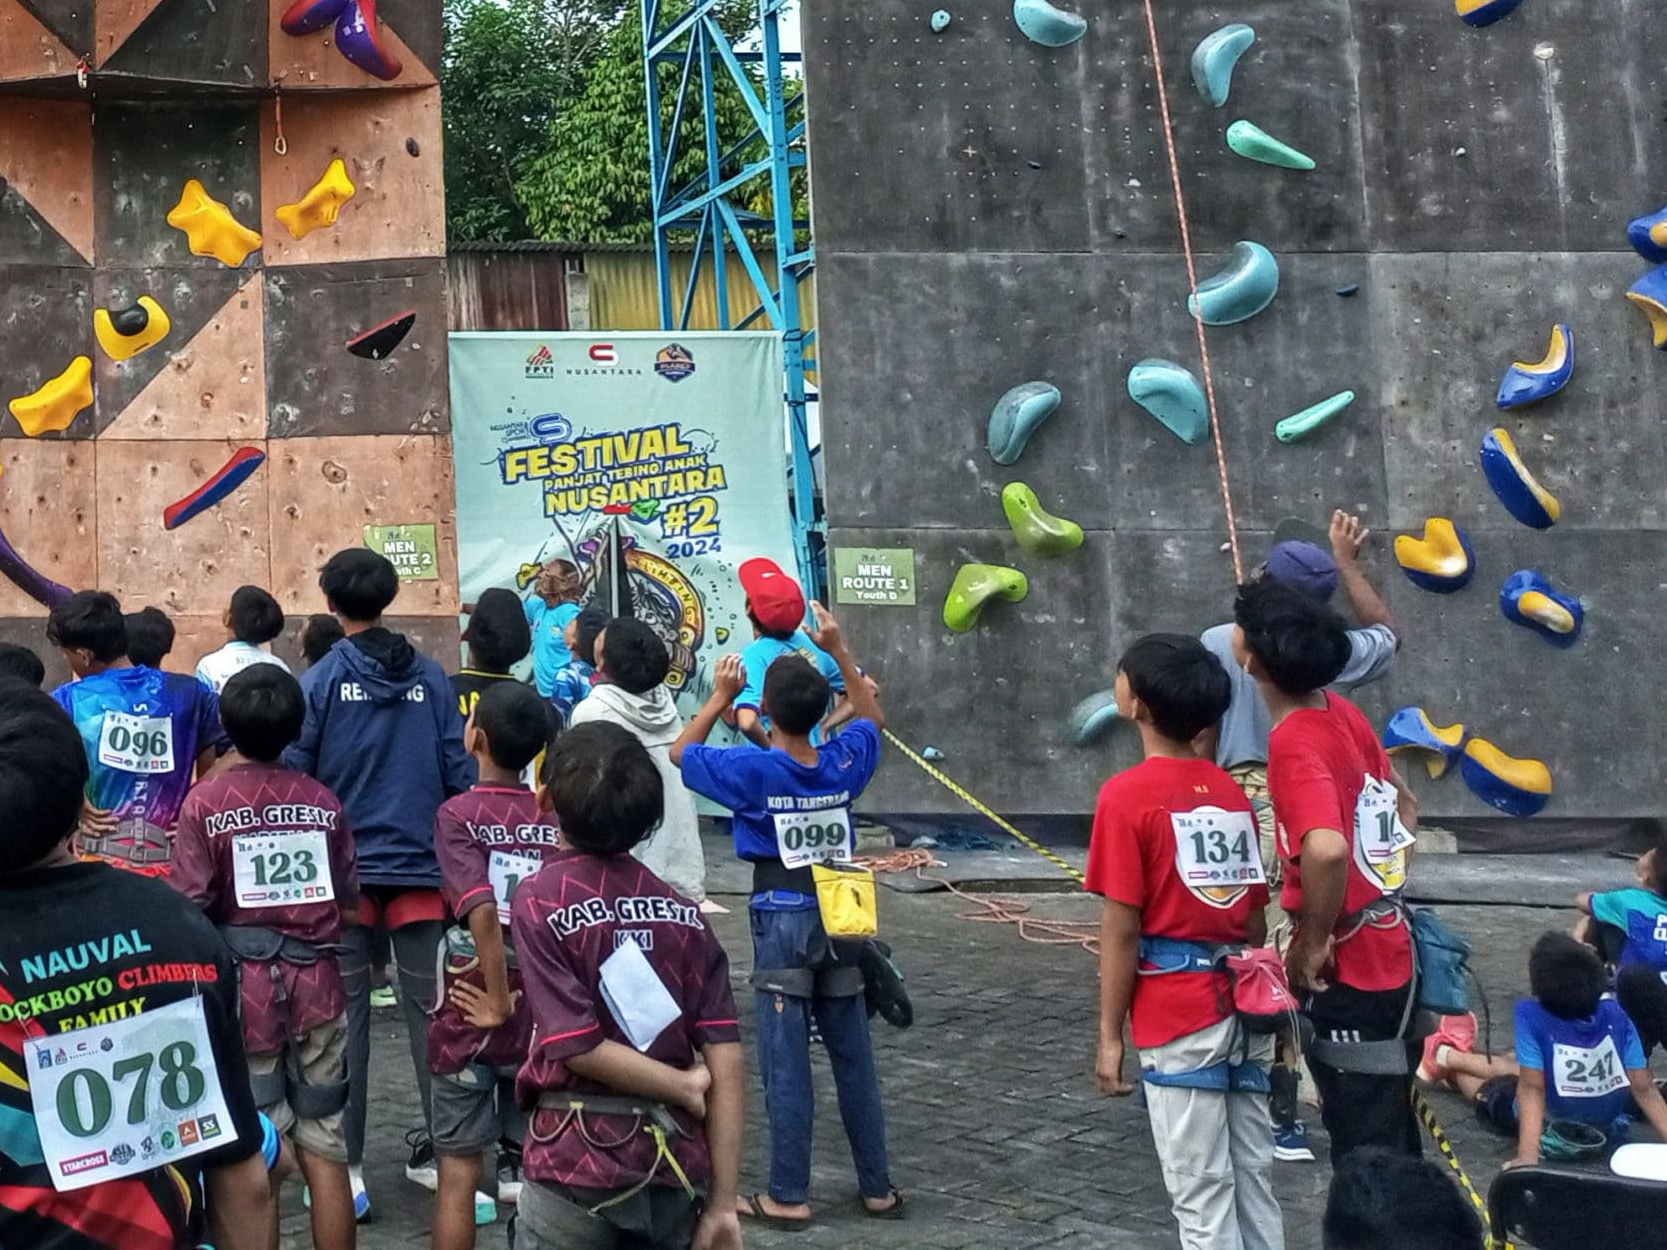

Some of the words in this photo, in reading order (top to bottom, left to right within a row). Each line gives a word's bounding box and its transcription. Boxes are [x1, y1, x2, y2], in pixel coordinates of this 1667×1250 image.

[504, 426, 691, 482] FESTIVAL
[545, 472, 603, 491] PANJAT
[608, 462, 659, 480] TEBING
[664, 454, 706, 472] ANAK
[547, 467, 725, 515] NUSANTARA
[663, 497, 719, 537] #2
[384, 541, 415, 553] MEN
[421, 553, 431, 564] 2
[668, 537, 722, 559] 2024
[842, 577, 895, 589] ROUTE
[899, 578, 909, 590] 1
[857, 564, 892, 576] MEN
[856, 591, 887, 600] Youth
[108, 726, 168, 757] 096
[767, 796, 795, 810] KOTA
[206, 807, 261, 838] KAB.
[263, 805, 336, 831] GRESIK
[784, 822, 847, 851] 099
[1190, 830, 1251, 864] 134
[250, 850, 318, 886] 123
[547, 898, 615, 941] KAB.
[616, 896, 705, 930] GRESIK
[20, 929, 152, 984] NAUVAL
[117, 963, 219, 990] CLIMBERS
[58, 996, 147, 1033] FAMILY
[1565, 1049, 1614, 1083] 247
[56, 1041, 206, 1138] 078
[63, 1154, 105, 1174] STARCROSS
